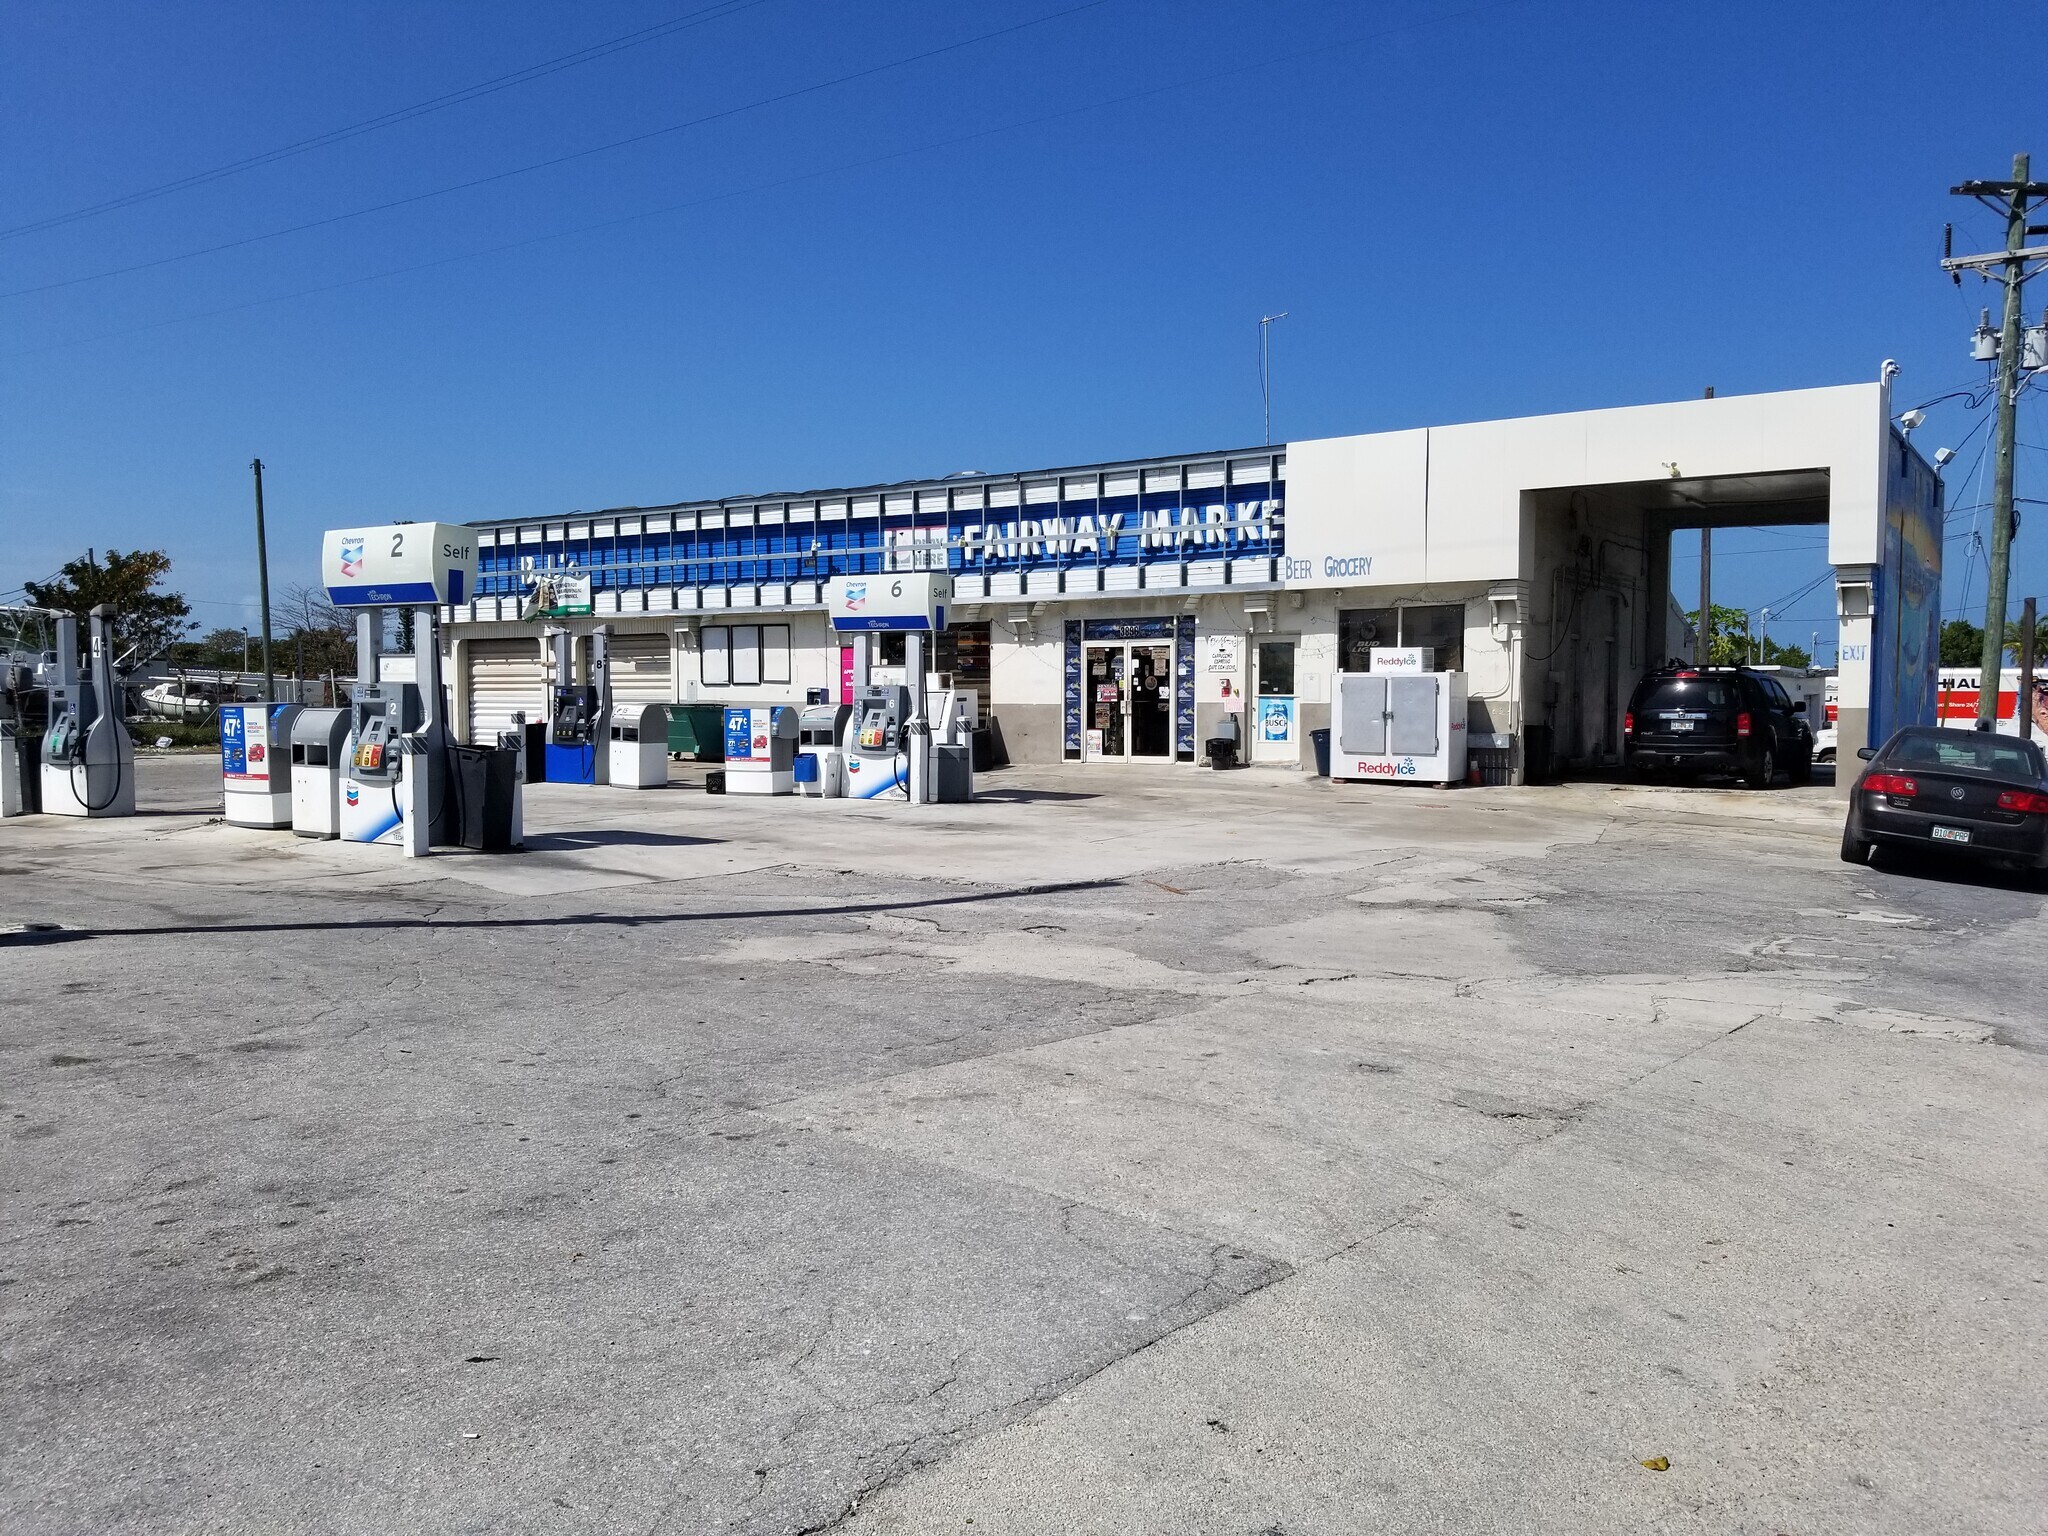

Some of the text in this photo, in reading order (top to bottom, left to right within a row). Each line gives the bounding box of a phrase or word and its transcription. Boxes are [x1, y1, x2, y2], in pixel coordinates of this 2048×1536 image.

[964, 513, 1124, 560] FAIRWAY
[1140, 499, 1283, 548] MARKE
[341, 537, 365, 545] Chevron
[391, 533, 404, 557] 2
[443, 544, 470, 560] Self
[915, 553, 943, 566] HERE
[1285, 555, 1372, 580] BEER GROCERY
[891, 580, 902, 597] 6
[933, 588, 948, 599] Self
[93, 637, 99, 657] 4
[1842, 645, 1867, 661] EXIT
[597, 660, 602, 669] 8
[1938, 678, 1980, 689] -HAU
[390, 703, 397, 715] 2
[889, 699, 895, 708] 6
[393, 833, 404, 841] TECH
